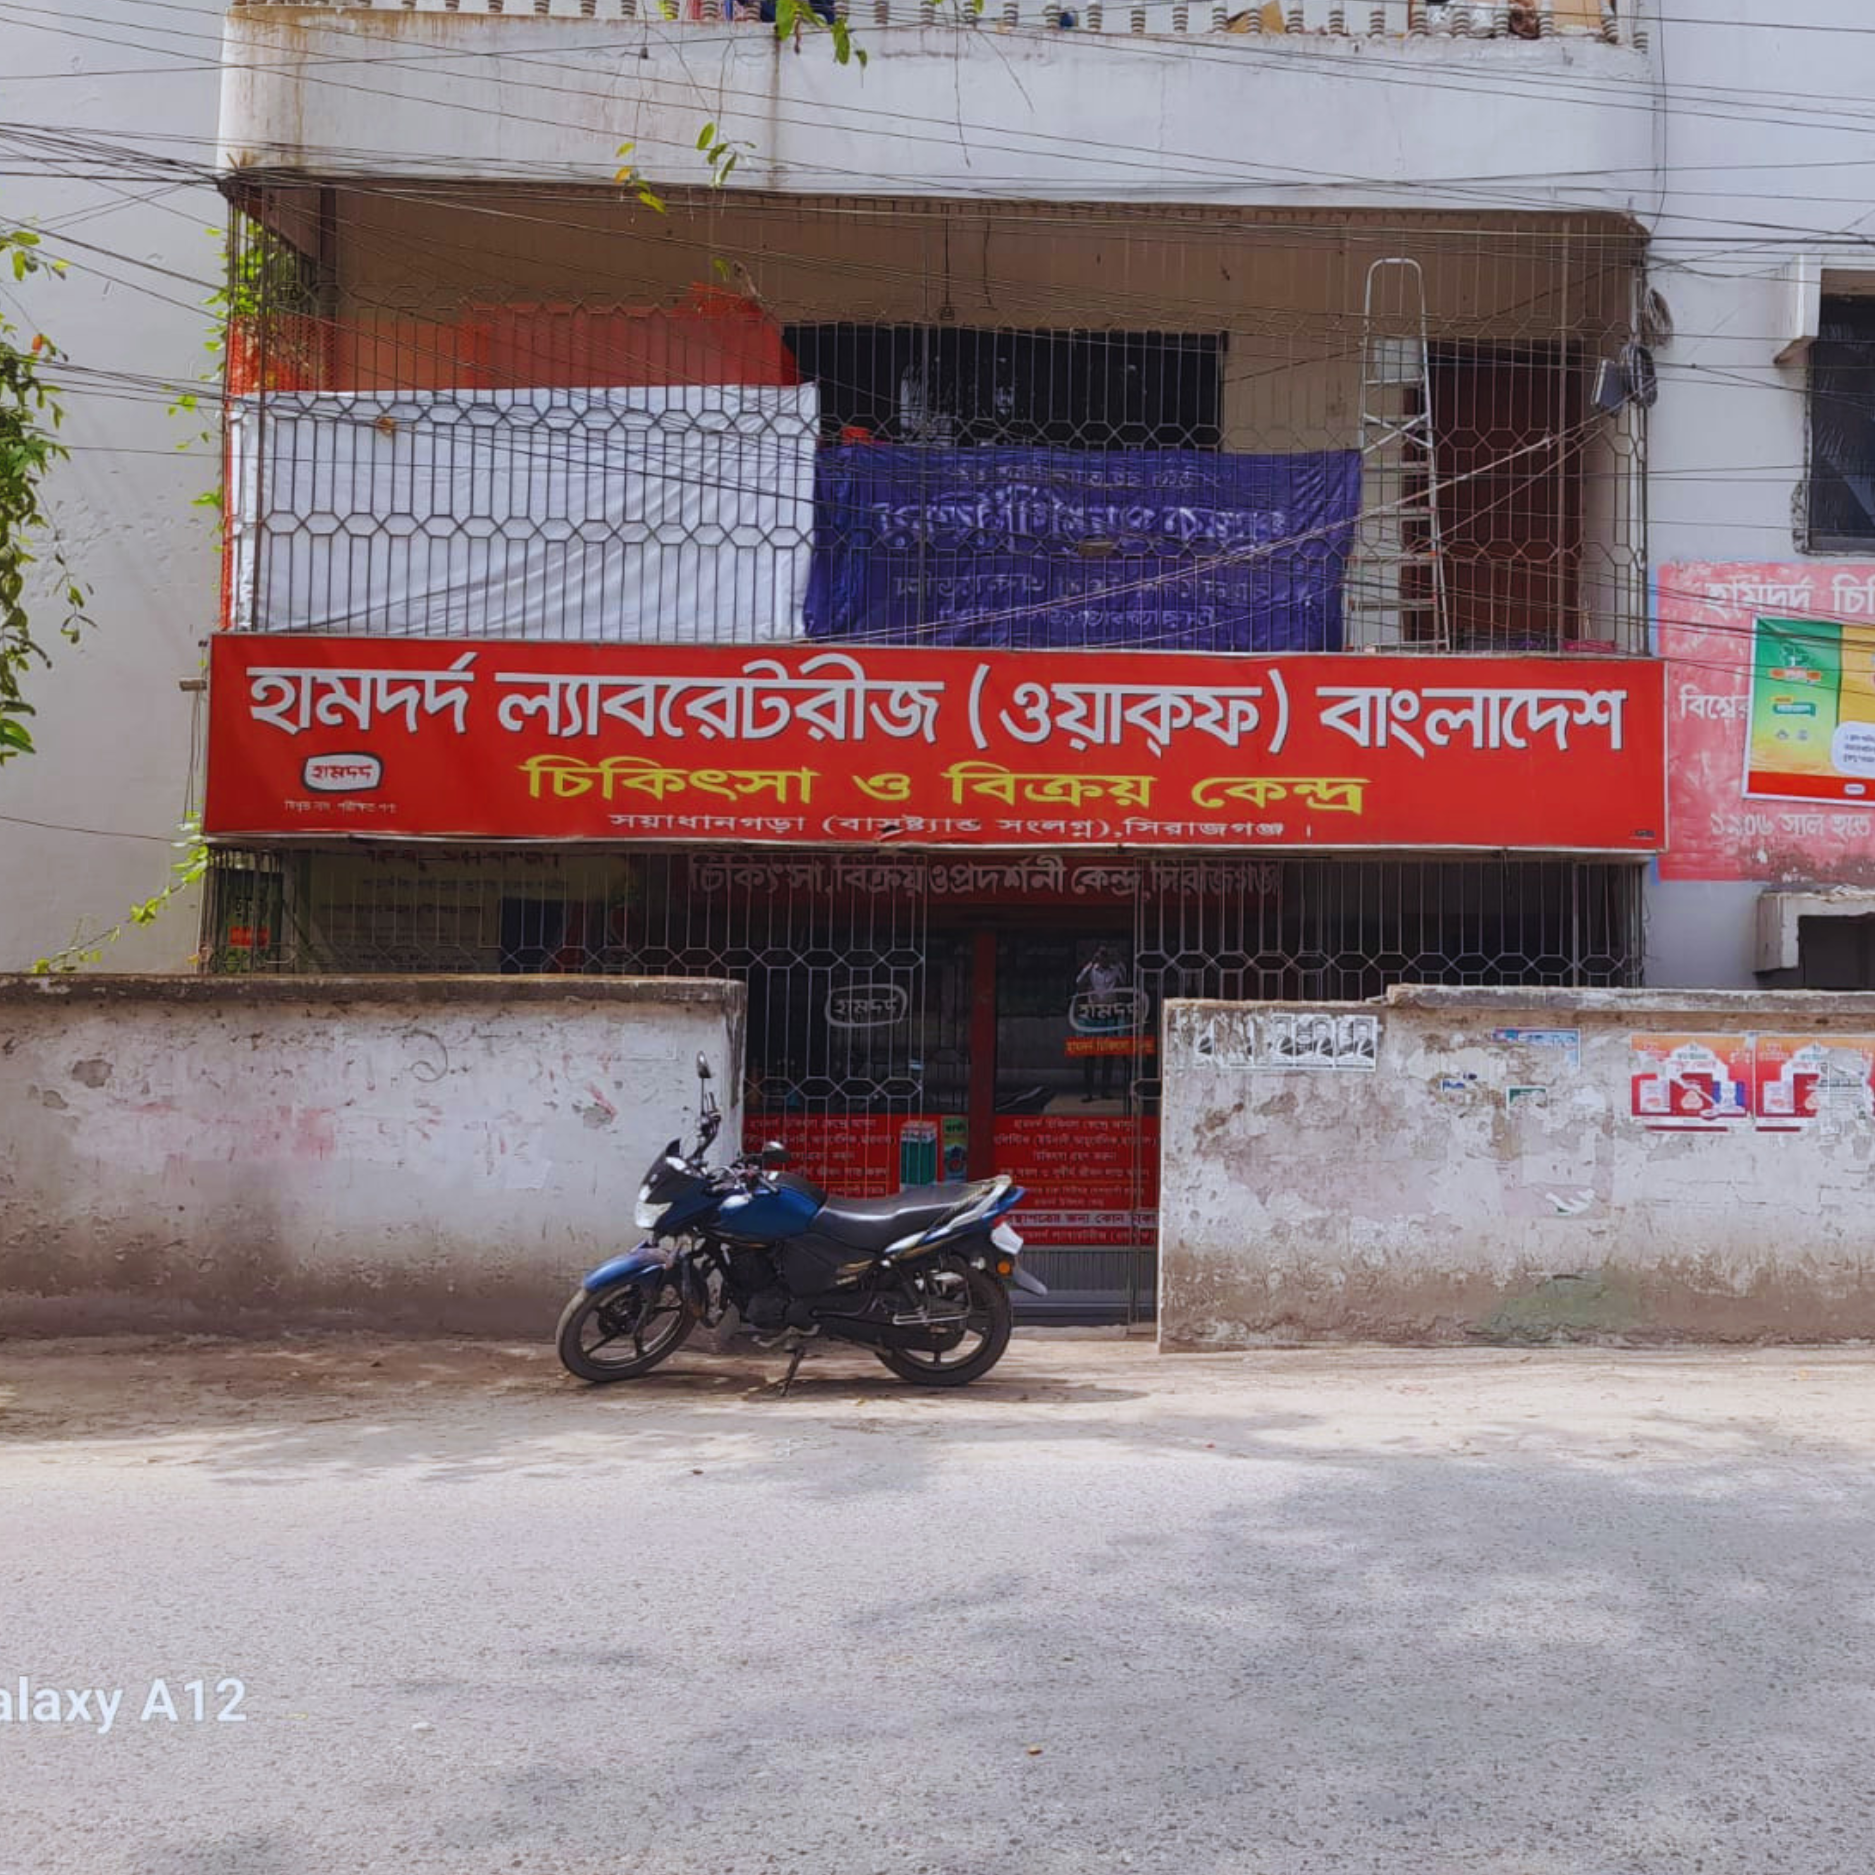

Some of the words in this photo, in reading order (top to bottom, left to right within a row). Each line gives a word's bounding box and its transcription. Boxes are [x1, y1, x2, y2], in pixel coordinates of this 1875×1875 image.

[247, 651, 477, 734] হামদর্দ
[496, 653, 945, 744] ল্যাবরেটরীজ
[1315, 686, 1627, 759] বাংলাদেশ
[518, 755, 821, 806] চিকিৎসা
[854, 774, 912, 803] ও
[941, 761, 1155, 811] বিক্রয়
[1191, 775, 1370, 817] কেন্দ্র
[609, 814, 806, 832] সয়াধানগড়া
[1779, 814, 1825, 836] সাল
